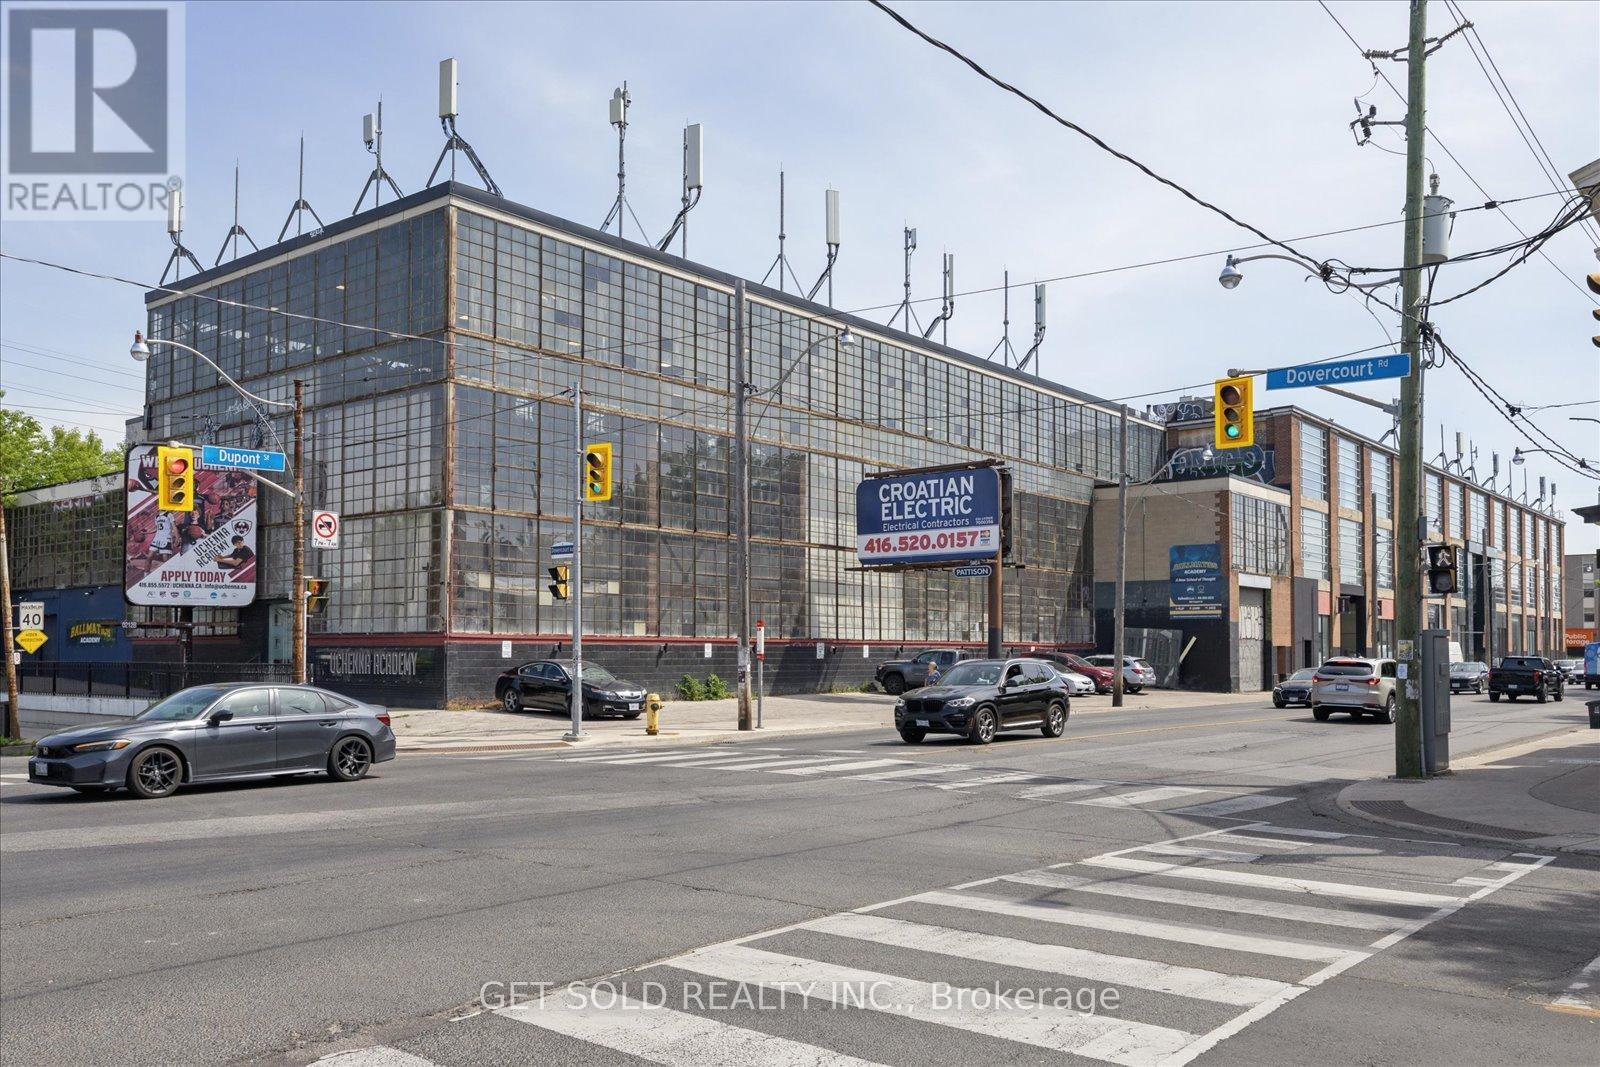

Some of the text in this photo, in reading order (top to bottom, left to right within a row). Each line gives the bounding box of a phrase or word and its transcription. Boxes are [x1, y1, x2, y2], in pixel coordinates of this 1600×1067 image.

[1286, 359, 1389, 384] Dovercourt Rd
[219, 449, 260, 465] Dupont
[879, 475, 974, 503] CROATIAN
[881, 495, 973, 521] ELECTRIC
[882, 522, 919, 532] Electrical
[921, 518, 970, 529] Contractors
[193, 527, 231, 557] UCHENNA
[864, 530, 979, 553] 416.520.0157
[195, 539, 230, 568] ACADEMY
[161, 571, 227, 583] APPLY TODAY
[956, 567, 989, 576] PATTISON
[22, 613, 42, 626] 40
[1566, 638, 1590, 646] torage
[330, 653, 418, 675] UCHENNA ACADEMY
